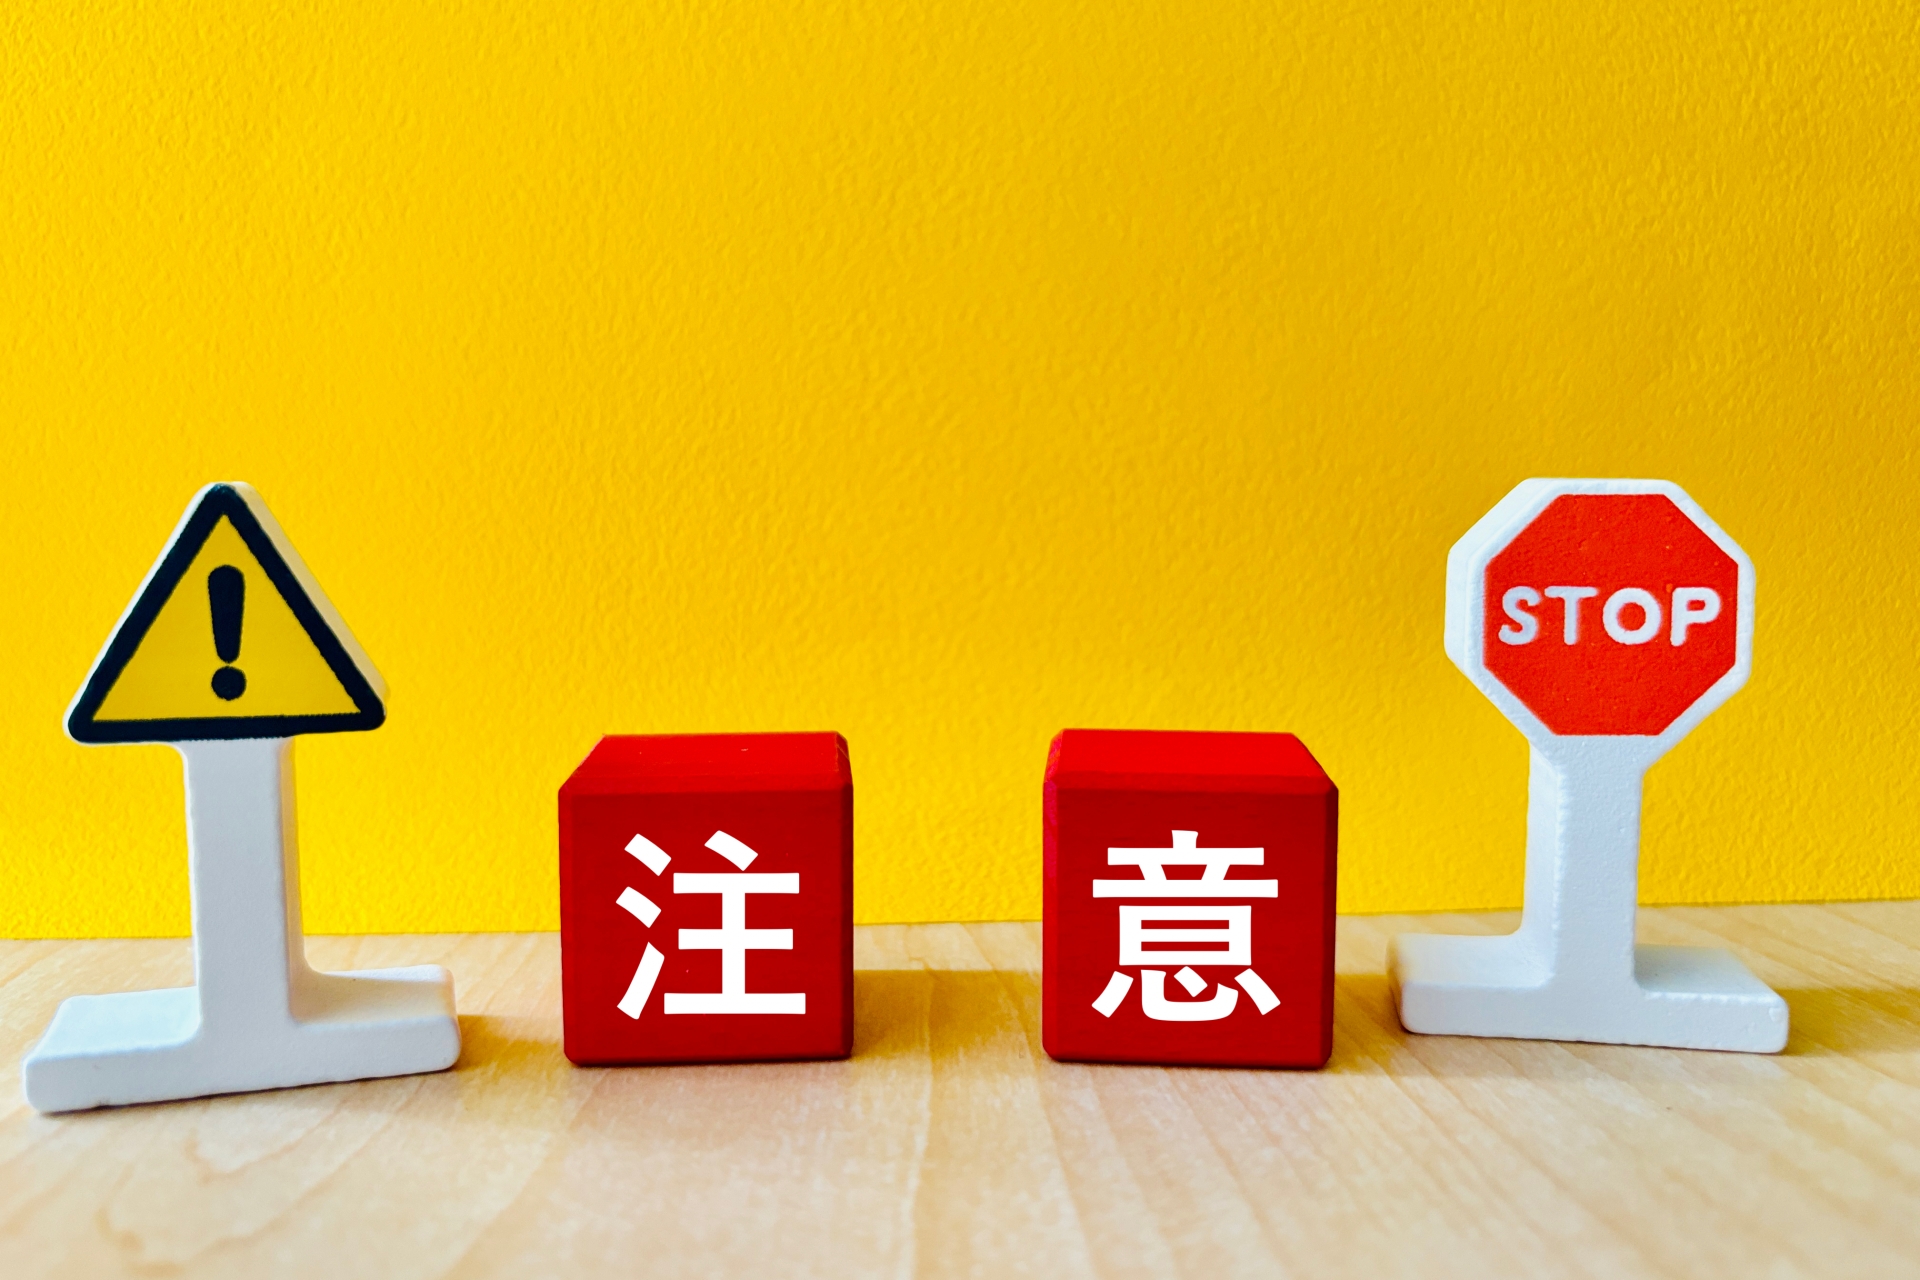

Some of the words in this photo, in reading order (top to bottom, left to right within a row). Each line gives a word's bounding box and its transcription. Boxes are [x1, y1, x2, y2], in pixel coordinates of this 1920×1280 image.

[1498, 585, 1721, 647] STOP
[615, 830, 806, 1020] 注
[1091, 829, 1281, 1022] 意
